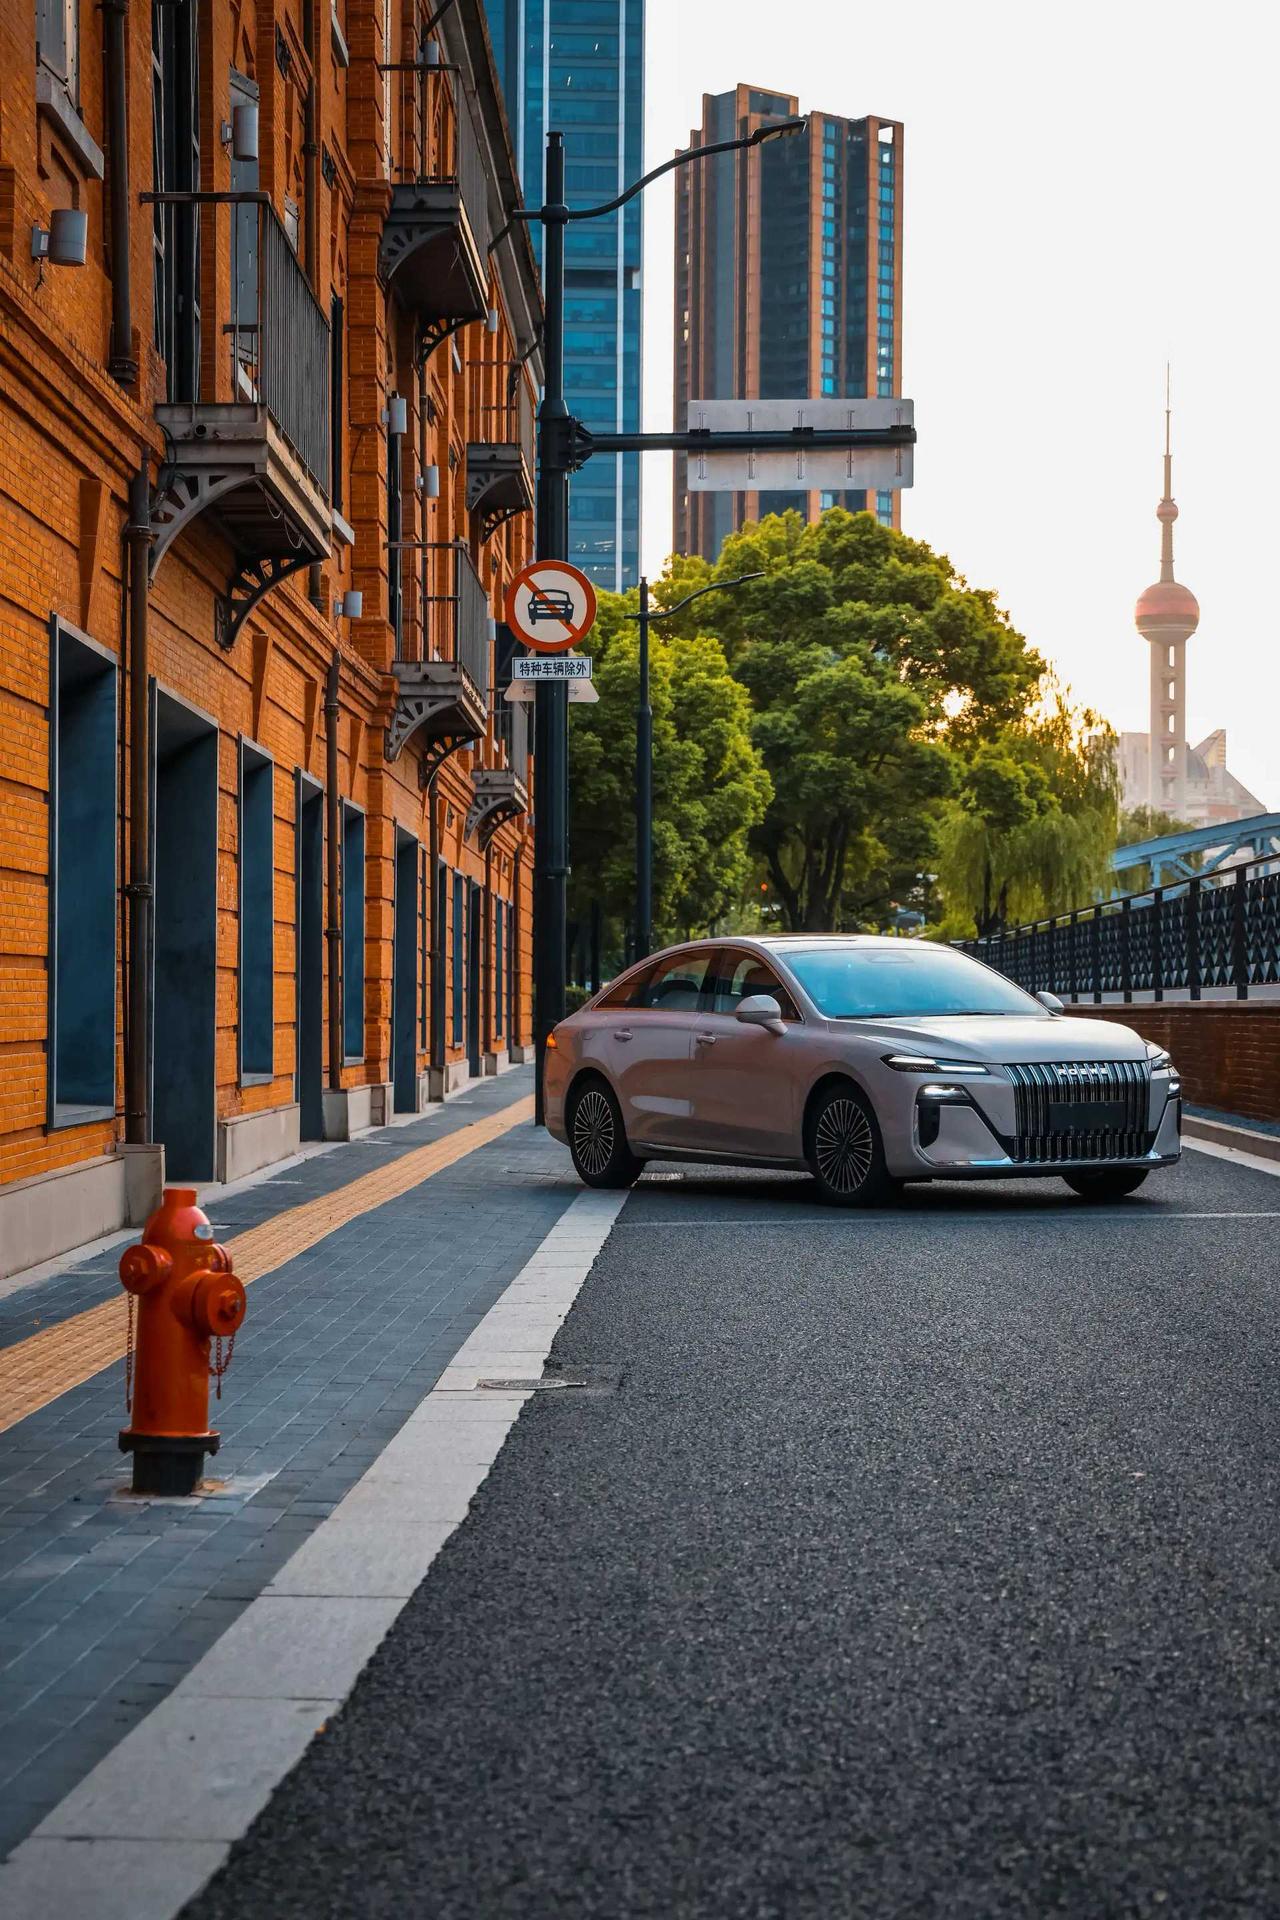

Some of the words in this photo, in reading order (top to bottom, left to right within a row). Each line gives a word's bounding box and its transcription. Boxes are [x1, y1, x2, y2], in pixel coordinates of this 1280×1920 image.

[520, 661, 587, 676] 特种车辆除外
